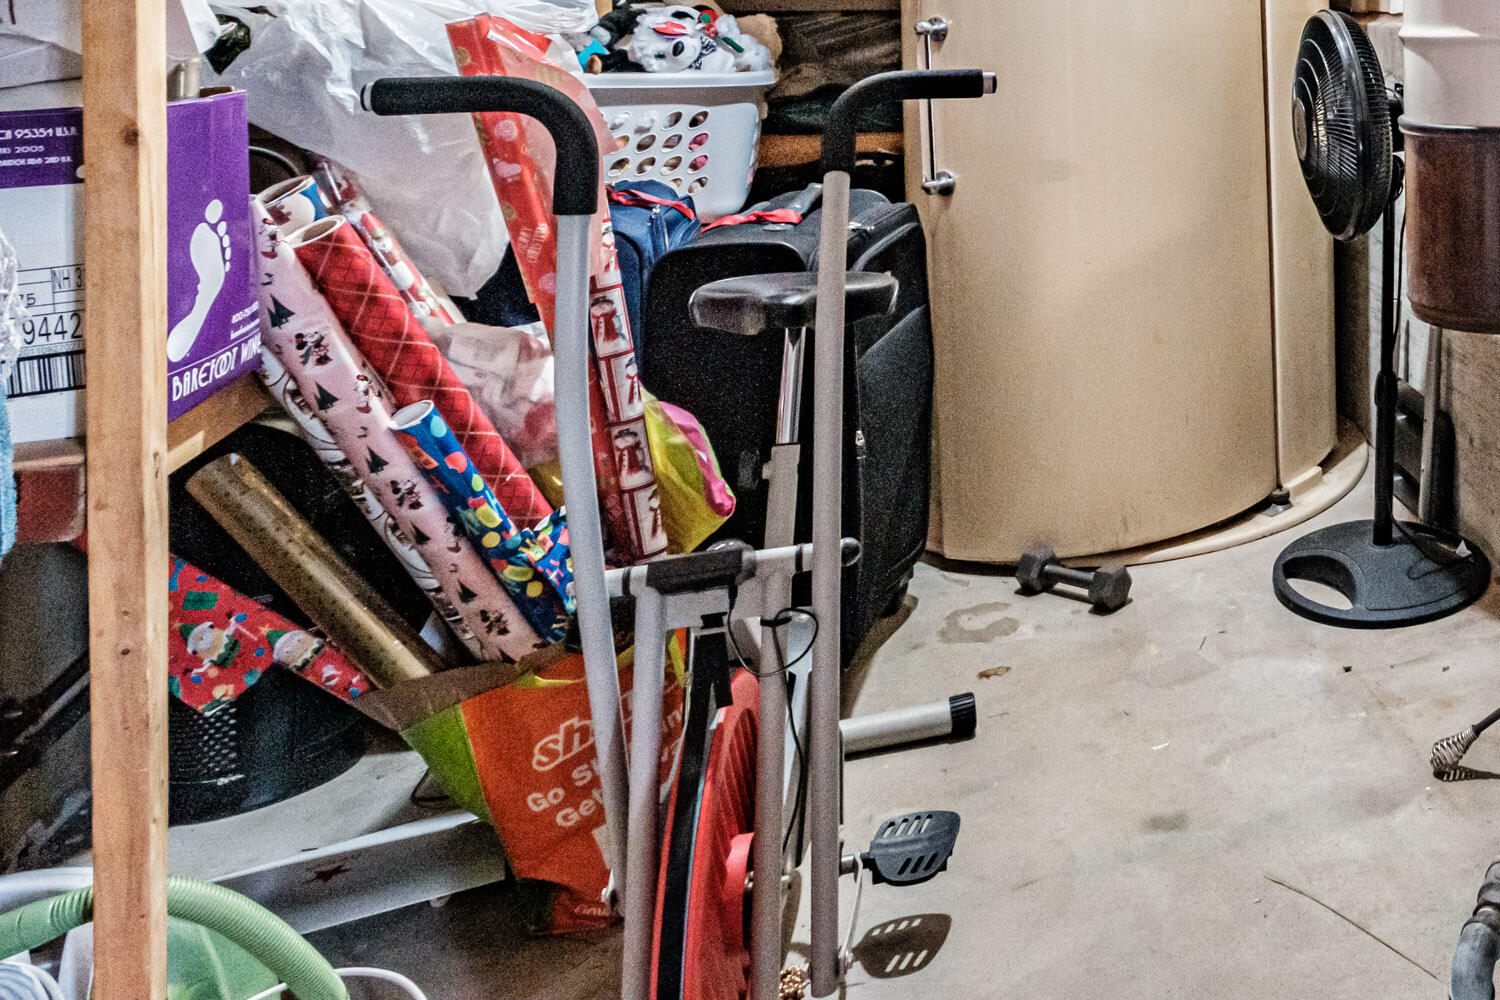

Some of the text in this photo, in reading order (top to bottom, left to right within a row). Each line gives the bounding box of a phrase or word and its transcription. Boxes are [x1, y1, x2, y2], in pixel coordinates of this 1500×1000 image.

[14, 127, 53, 139] 95354
[172, 346, 239, 402] BAREFOOT
[526, 787, 565, 812] Go
